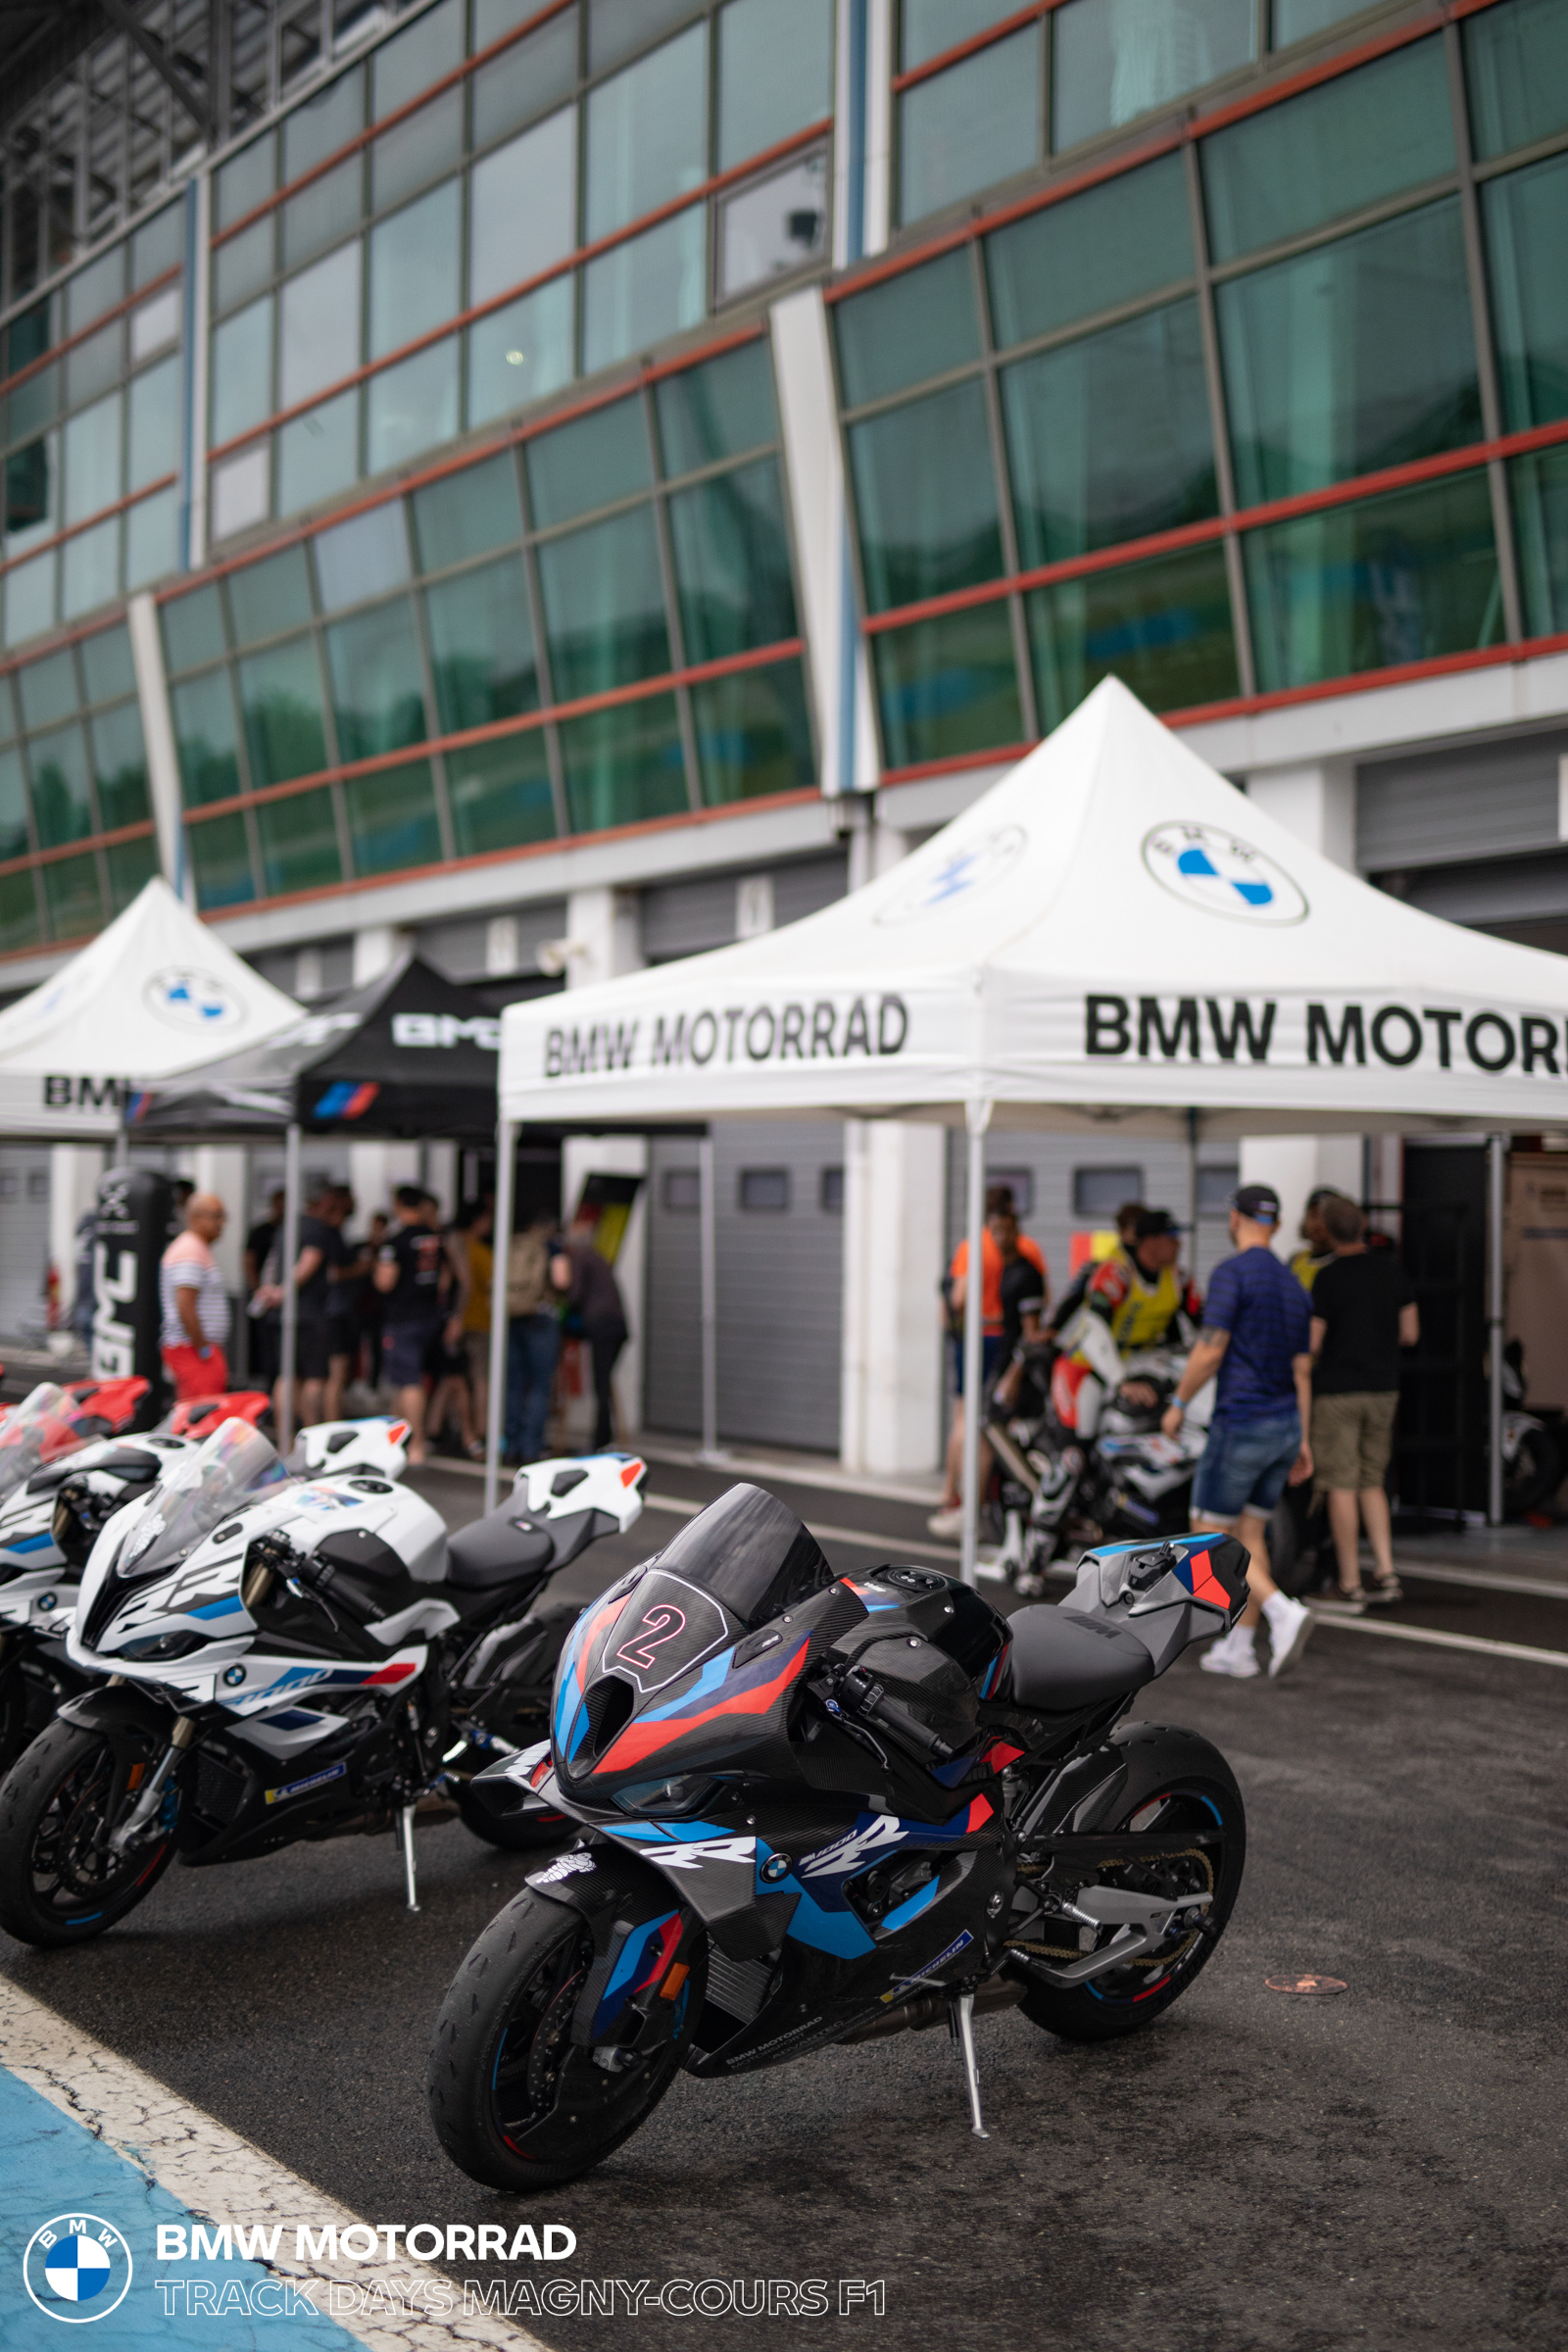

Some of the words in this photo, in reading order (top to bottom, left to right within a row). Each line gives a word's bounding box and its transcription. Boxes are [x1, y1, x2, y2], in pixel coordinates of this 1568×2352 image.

[545, 1021, 638, 1077] BMW
[652, 993, 908, 1066] MOTORRAD
[1086, 995, 1277, 1061] BMW
[1306, 1002, 1568, 1075] MOTOR
[43, 1074, 130, 1107] BM
[616, 1604, 686, 1669] 2
[909, 1939, 964, 1984] MICHELIN
[725, 2047, 758, 2065] BMW
[758, 2016, 823, 2051] MOTORRAD
